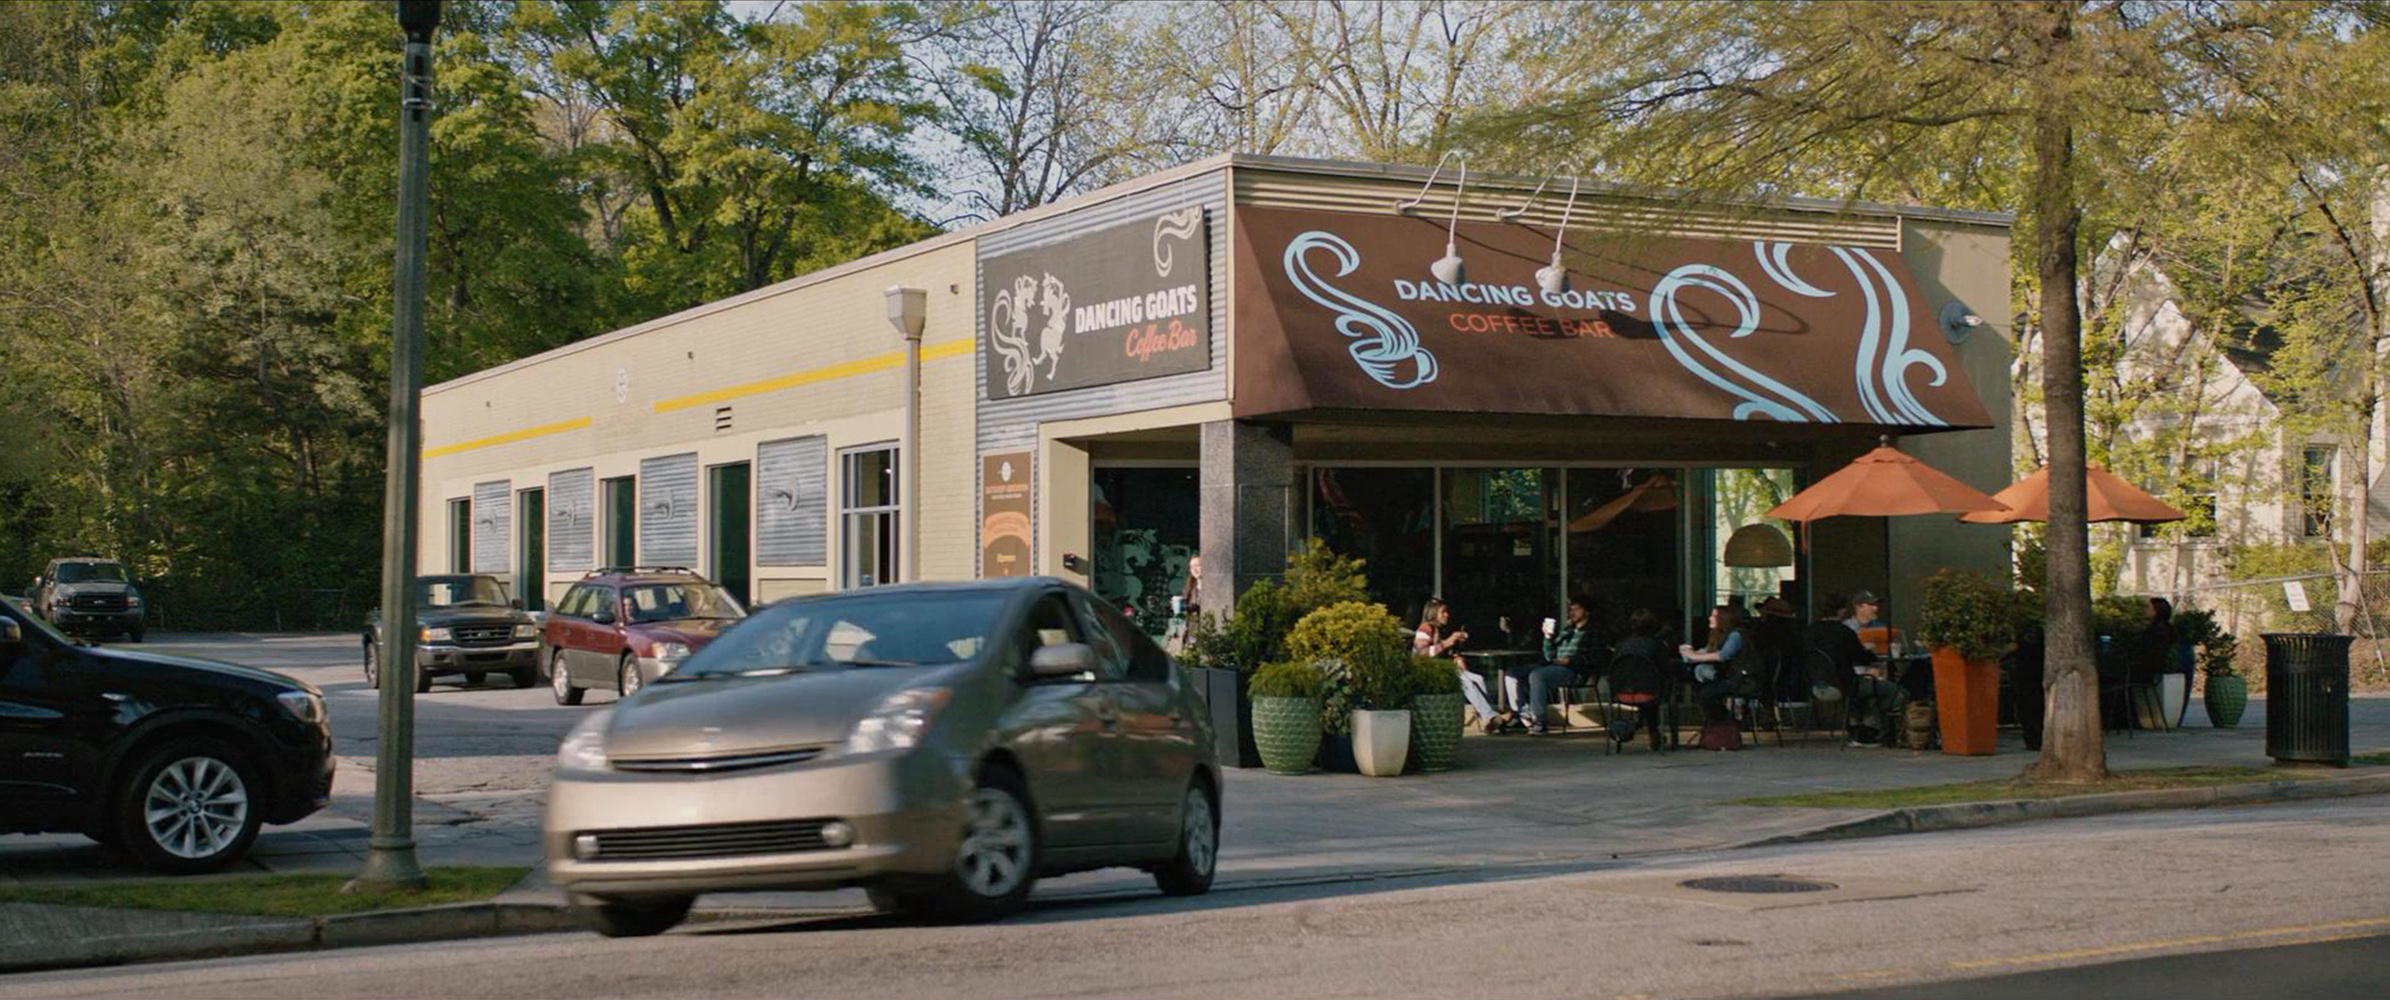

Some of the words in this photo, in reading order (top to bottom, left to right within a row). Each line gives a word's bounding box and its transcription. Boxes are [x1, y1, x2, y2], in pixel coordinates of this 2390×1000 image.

[1075, 296, 1143, 334] DANCING
[1145, 285, 1198, 320] GOATS
[1394, 279, 1535, 306] DANCING
[1541, 288, 1637, 312] GOATS
[1125, 323, 1167, 362] Coffee
[1168, 319, 1197, 350] Bar
[1449, 312, 1555, 335] COFFEE
[1561, 320, 1615, 338] BAR
